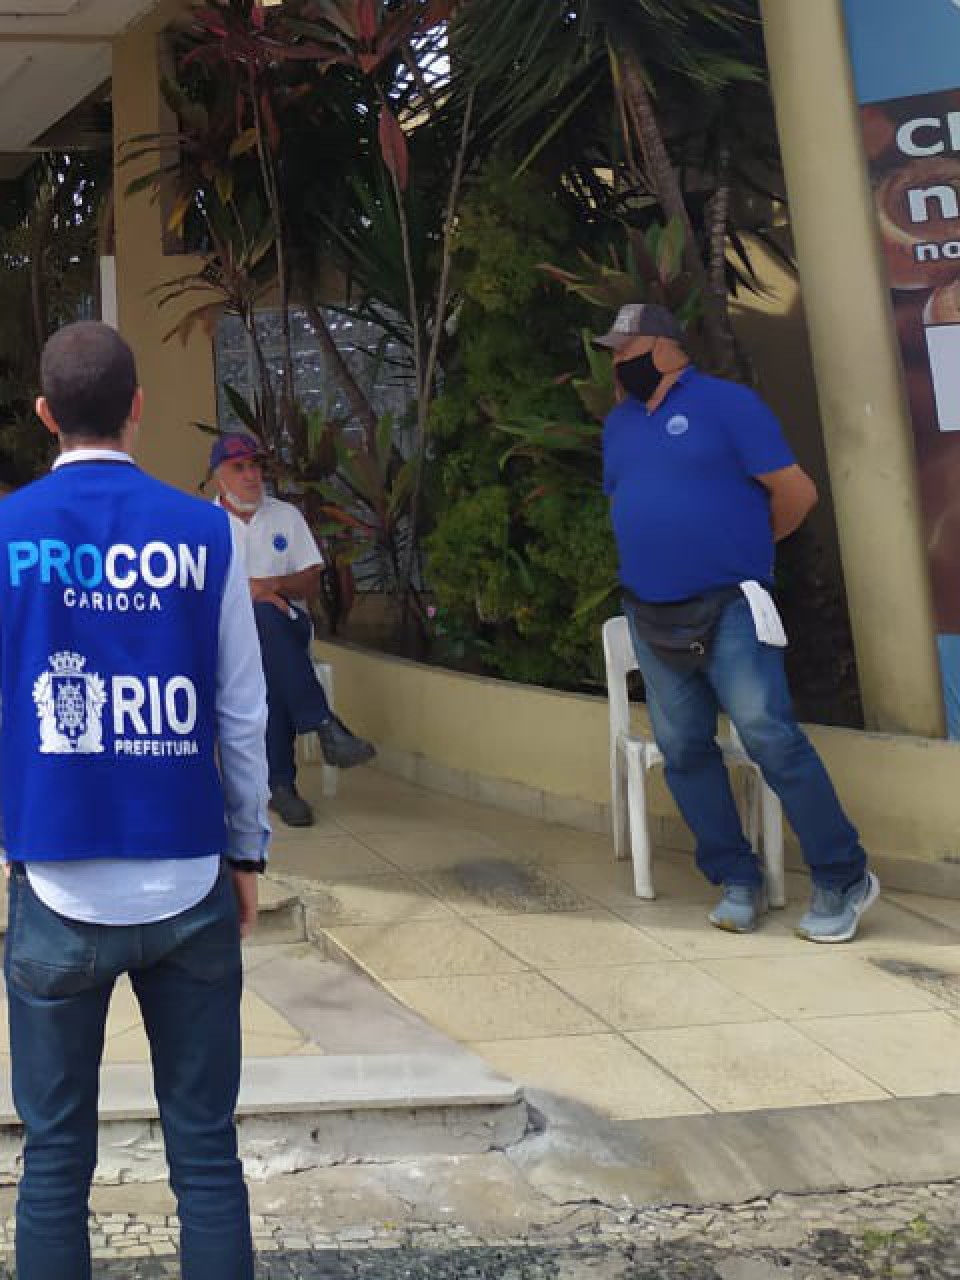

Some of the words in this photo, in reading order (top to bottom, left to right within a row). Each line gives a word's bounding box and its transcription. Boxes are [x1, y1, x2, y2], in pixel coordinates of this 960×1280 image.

[7, 539, 207, 590] PROCON
[63, 587, 162, 611] CARIOCA
[111, 675, 197, 736] RIO
[114, 739, 199, 757] PREFEITURA
